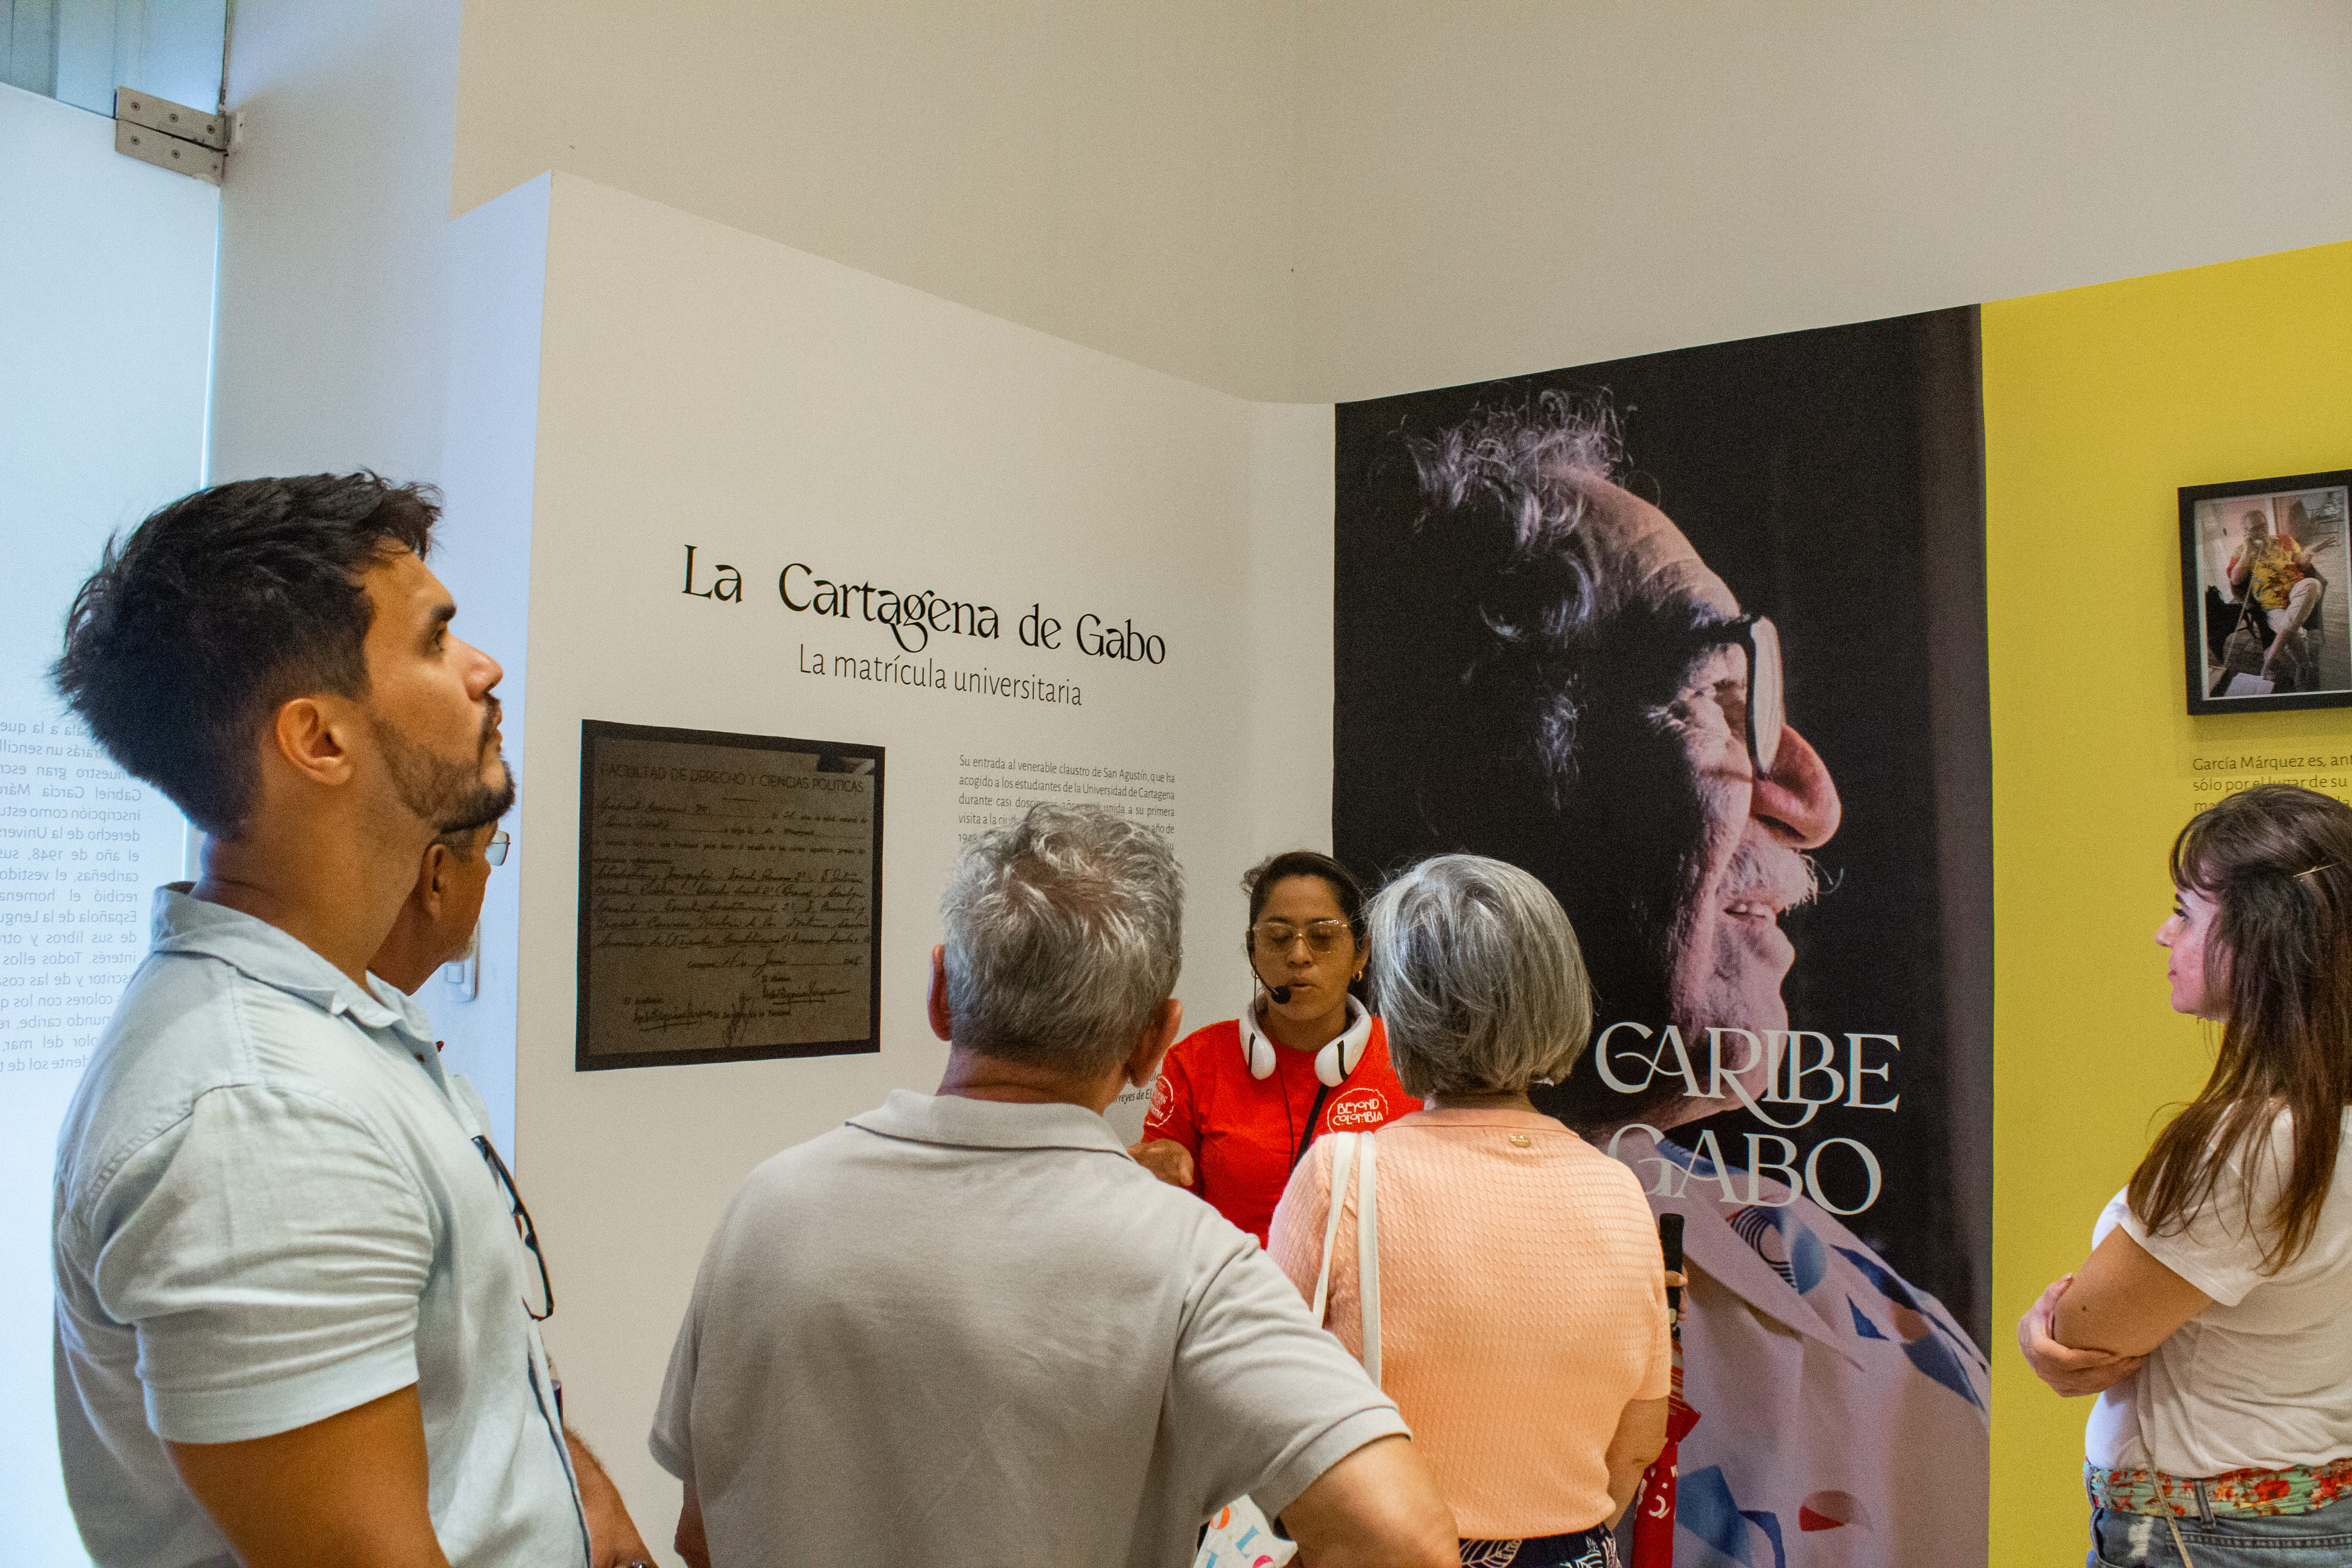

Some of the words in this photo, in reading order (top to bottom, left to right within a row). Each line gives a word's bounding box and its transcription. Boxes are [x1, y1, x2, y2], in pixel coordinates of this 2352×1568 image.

[681, 544, 743, 603] La
[778, 563, 1000, 653] Cartagena
[1018, 604, 1061, 650] de
[1076, 613, 1166, 665] Gabo
[799, 643, 825, 676] La
[833, 653, 947, 689] matrícula
[954, 668, 1083, 706] universitaria
[960, 755, 970, 766] Su
[973, 757, 1005, 769] entrada
[1008, 760, 1015, 769] al
[1018, 761, 1057, 774] venerable
[1059, 763, 1089, 777] claustro
[1092, 766, 1101, 777] de
[1103, 768, 1117, 779] San
[1151, 771, 1165, 784] que
[1166, 771, 1175, 783] ha
[2193, 757, 2237, 770] García
[2240, 755, 2304, 770] Márquez
[2308, 757, 2327, 768] es,
[760, 774, 809, 789] CIENCIAS
[959, 775, 993, 789] acogido
[995, 779, 1000, 788] a
[1002, 777, 1013, 789] los
[1015, 778, 1061, 792] estudiantes
[1063, 781, 1073, 793] de
[1074, 782, 1081, 794] la
[1083, 783, 1127, 797] Universidad
[1128, 786, 1137, 797] de
[1138, 787, 1175, 801] Cartagena
[2193, 778, 2222, 791] sólo
[2226, 780, 2249, 793] por
[2309, 775, 2328, 788] de
[2331, 779, 2347, 787] su
[959, 793, 992, 806] durante
[996, 797, 1011, 807] casi
[1136, 806, 1144, 815] su
[1147, 806, 1175, 818] primera
[958, 812, 981, 825] visita
[982, 815, 988, 825] a
[990, 813, 997, 825] la
[1165, 824, 1175, 834] de
[1595, 1022, 1901, 1129] CARIBE
[1137, 1089, 1144, 1100] de
[1337, 1098, 1379, 1115] BEYOND
[1333, 1111, 1383, 1126] COLOMBIA
[1607, 1123, 1882, 1216] GABO
